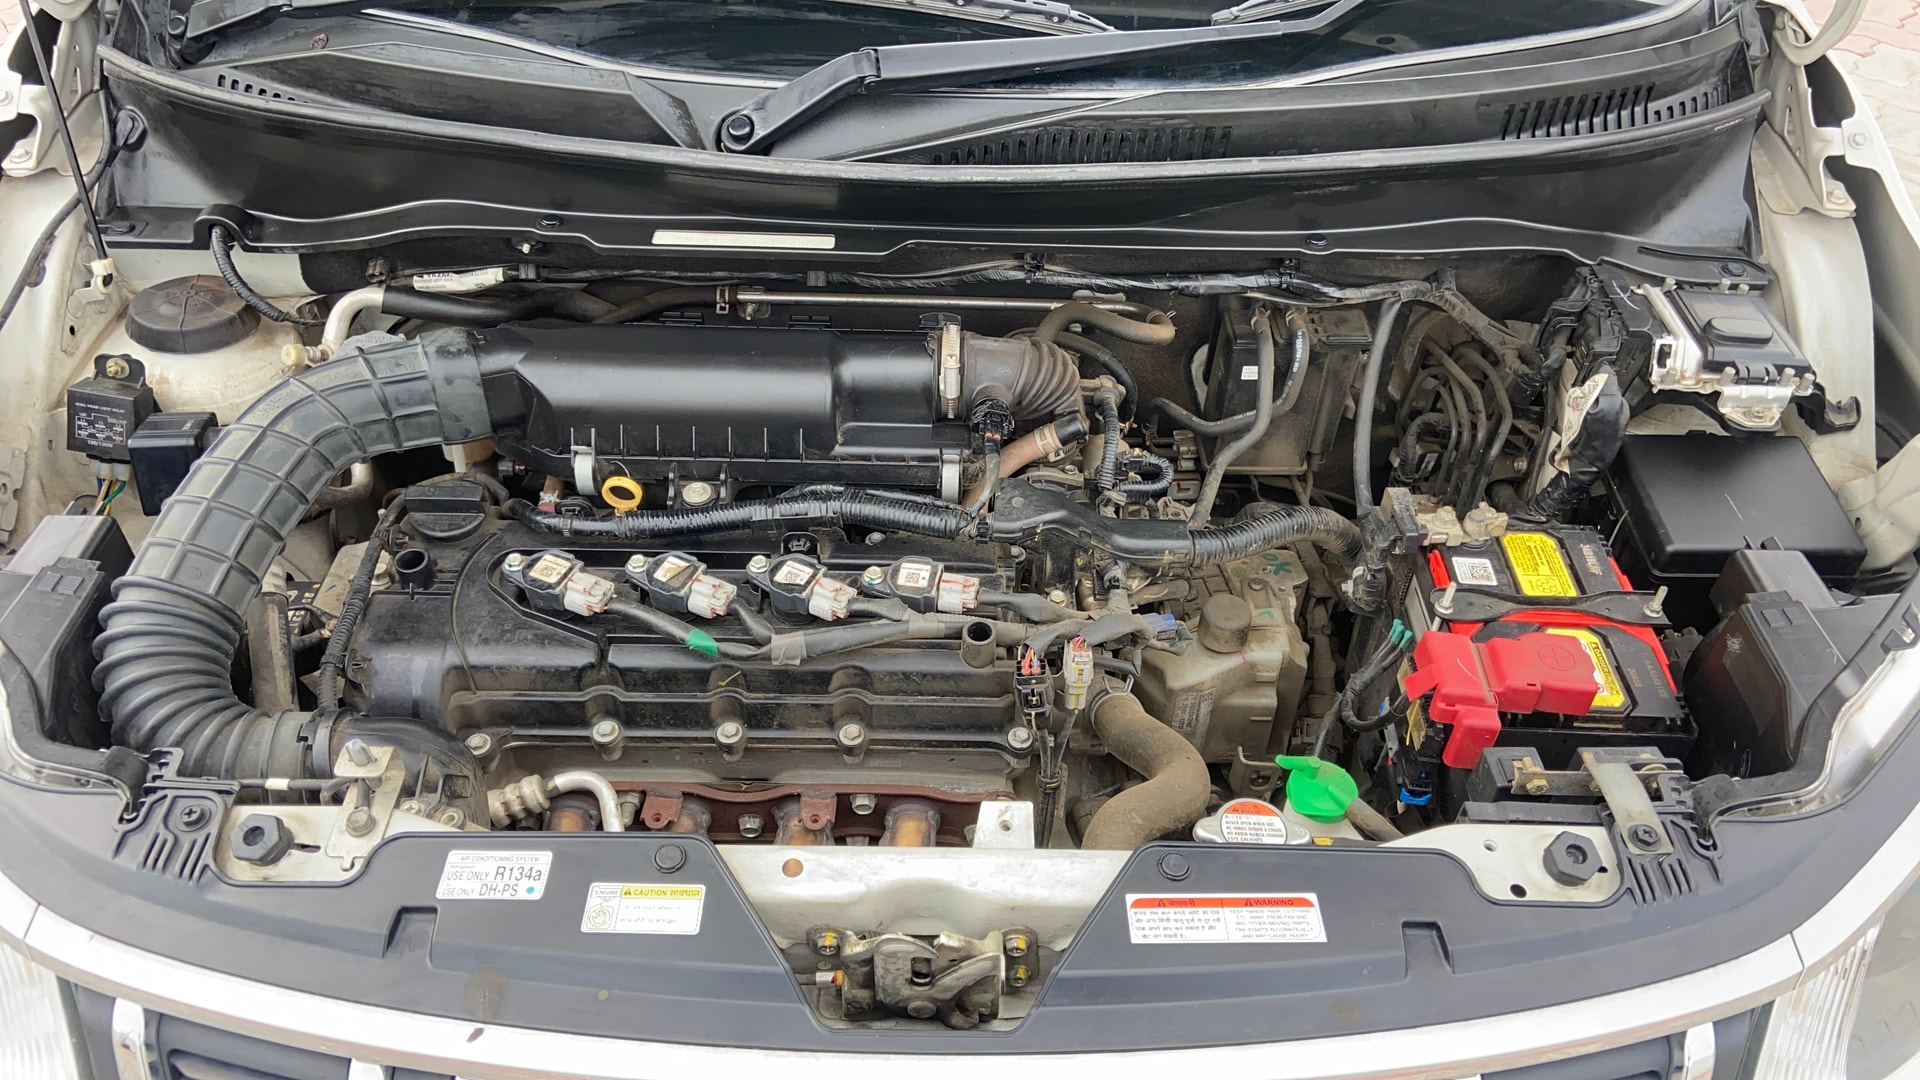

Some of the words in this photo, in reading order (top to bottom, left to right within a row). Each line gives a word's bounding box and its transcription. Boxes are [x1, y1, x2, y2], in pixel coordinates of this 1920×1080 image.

[447, 871, 465, 880] USE
[466, 871, 491, 880] ONLY
[494, 866, 542, 881] R134a
[442, 888, 456, 896] USE
[457, 888, 475, 896] ONLY
[479, 883, 519, 896] DH-PS
